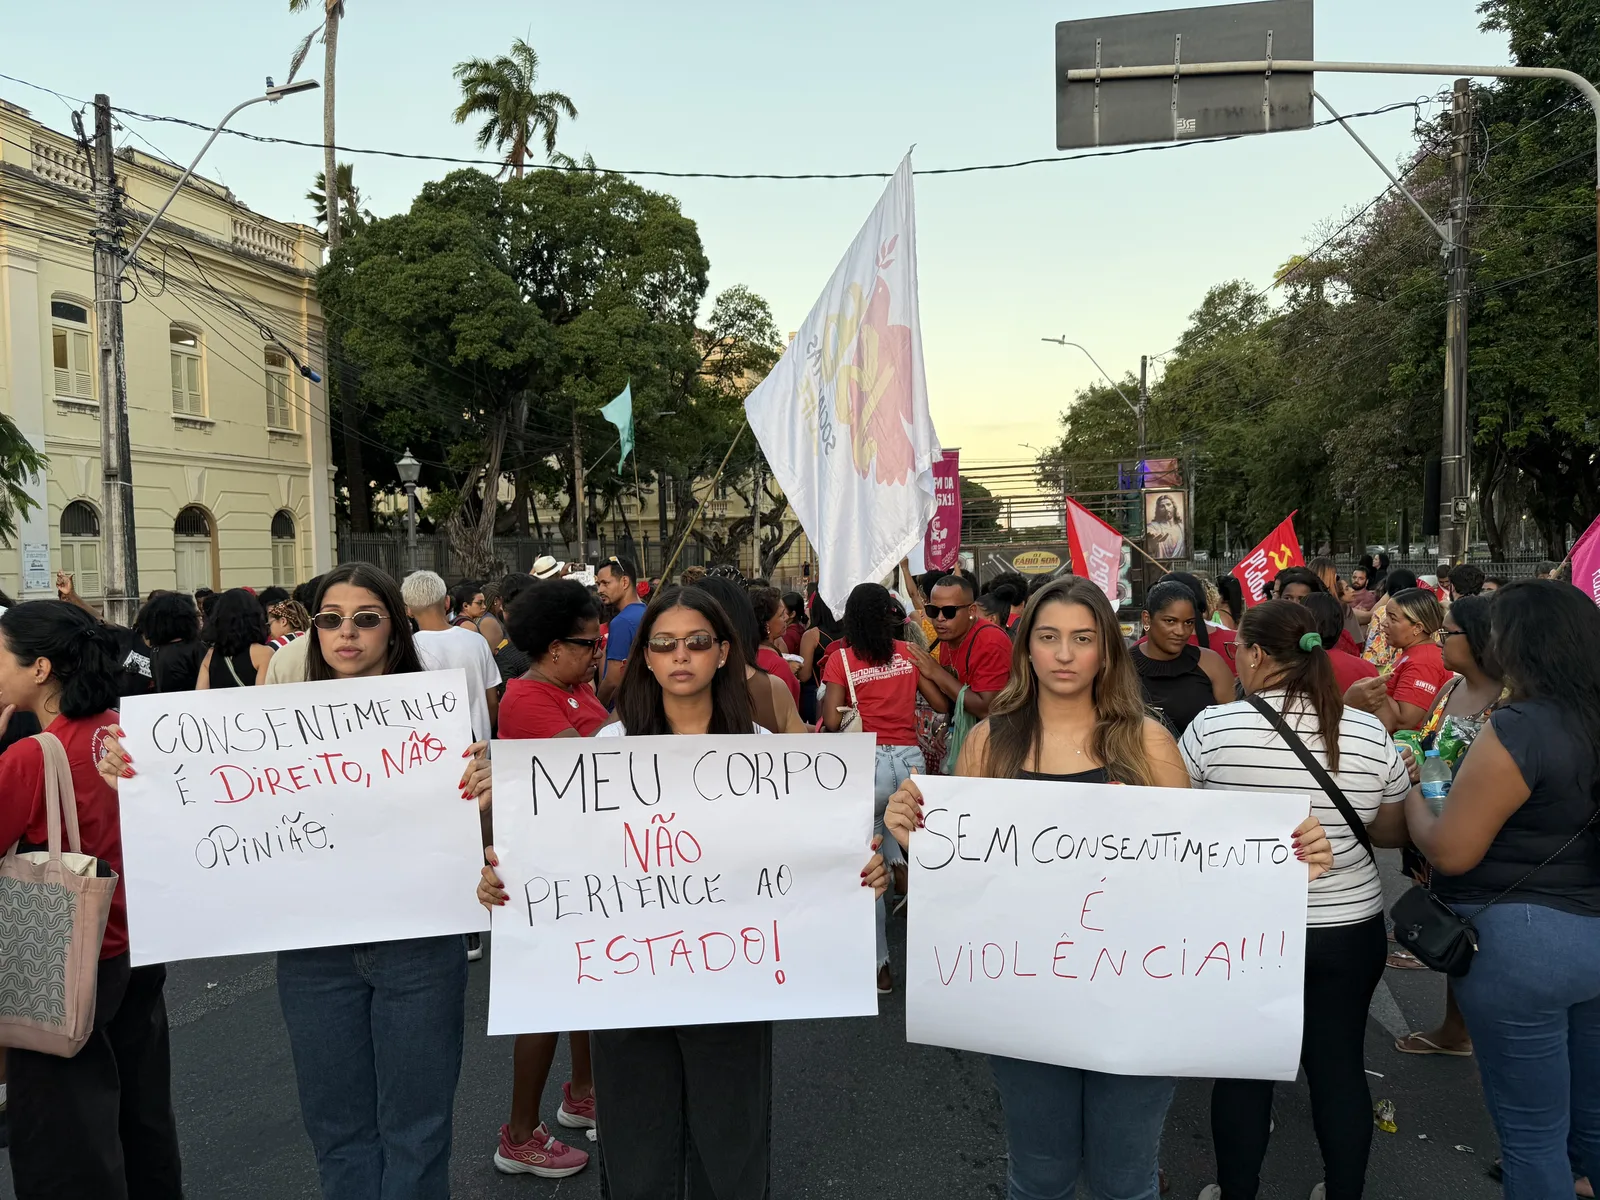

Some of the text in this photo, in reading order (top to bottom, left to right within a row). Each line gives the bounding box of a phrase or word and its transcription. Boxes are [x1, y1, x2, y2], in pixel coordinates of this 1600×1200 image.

[1040, 557, 1058, 565] SOM
[173, 763, 196, 806] É
[381, 730, 447, 778] NÃO
[531, 750, 847, 816] MEU CORPO
[623, 812, 702, 873] NÃO
[916, 808, 1289, 873] SEM CONSENTIMENTO
[524, 864, 793, 927] PERTENCE AO
[1080, 877, 1108, 932] É
[575, 919, 787, 986] ESTADO!
